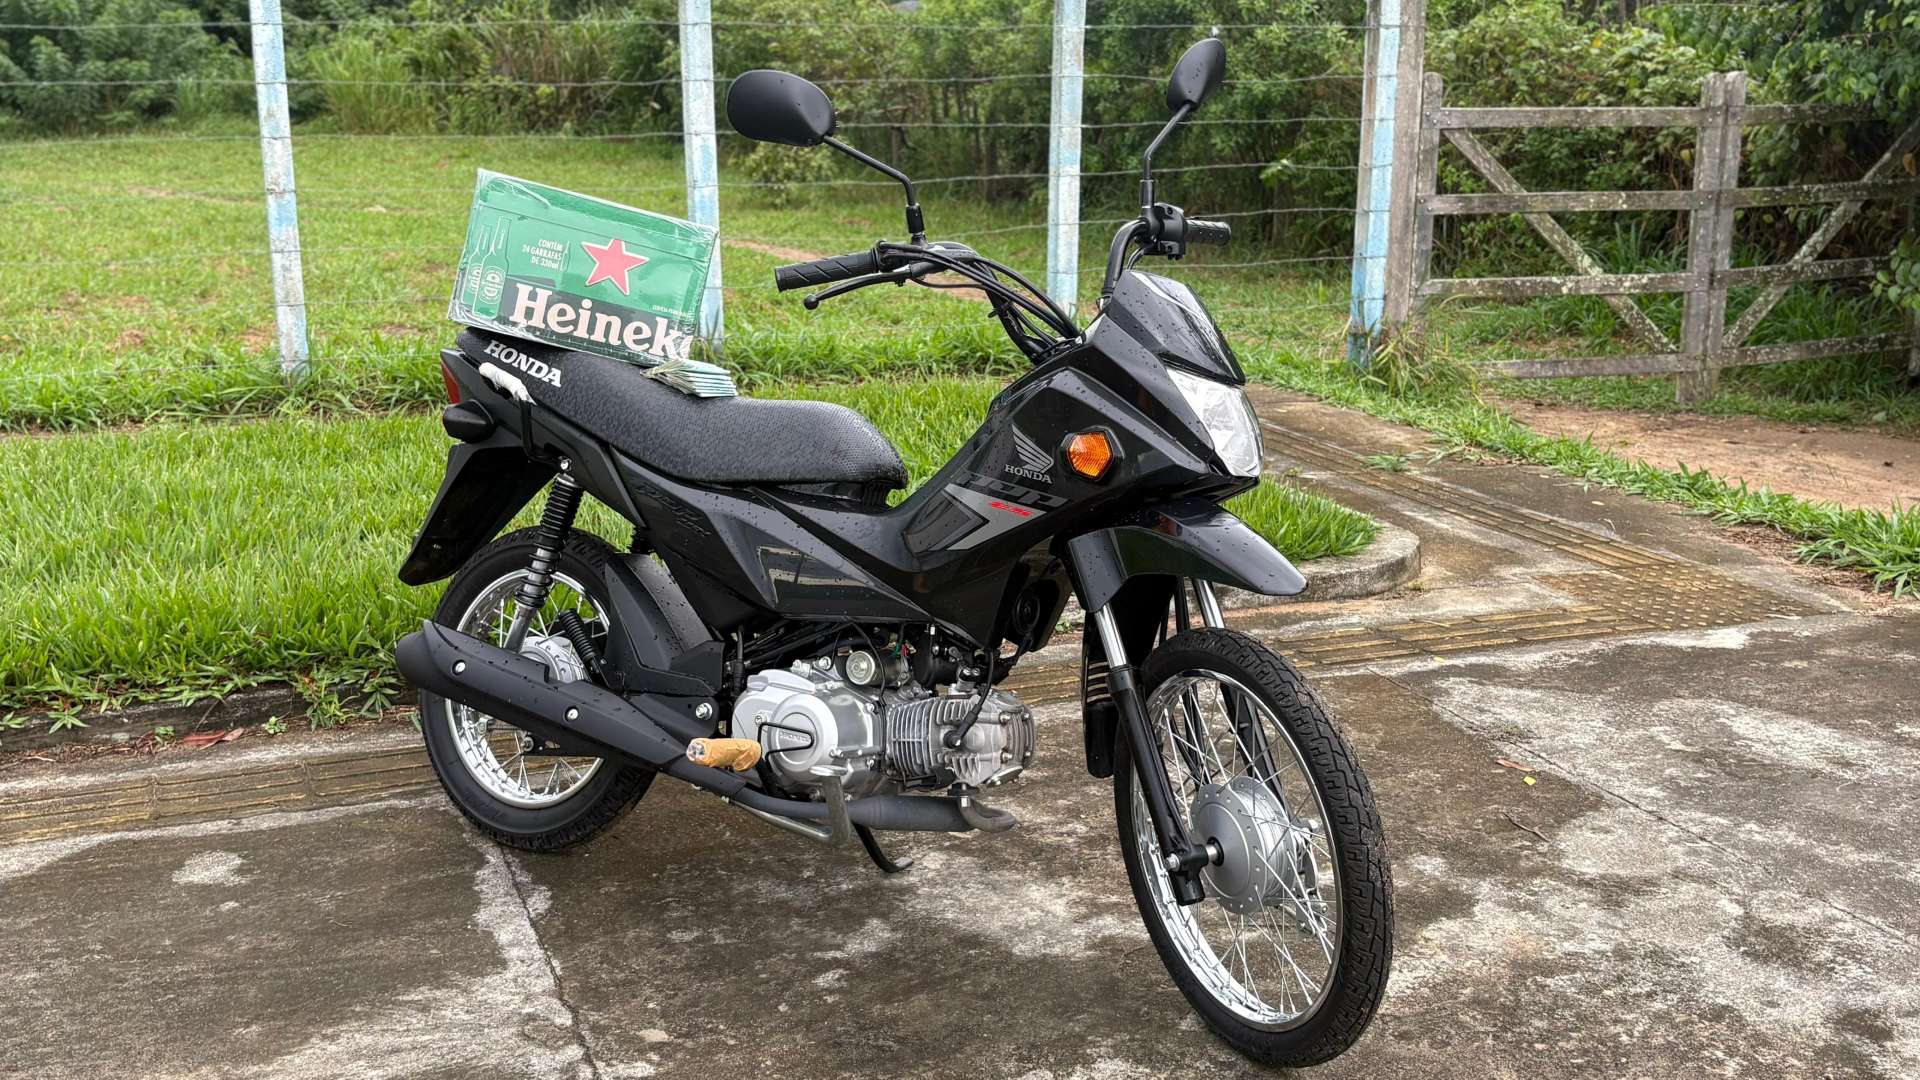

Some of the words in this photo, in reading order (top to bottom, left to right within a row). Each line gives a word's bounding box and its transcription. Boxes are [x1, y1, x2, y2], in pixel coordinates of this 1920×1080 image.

[530, 247, 562, 260] GARRAFAS
[531, 256, 540, 264] DE
[484, 340, 562, 388] HONDA
[1004, 464, 1053, 484] HONDA
